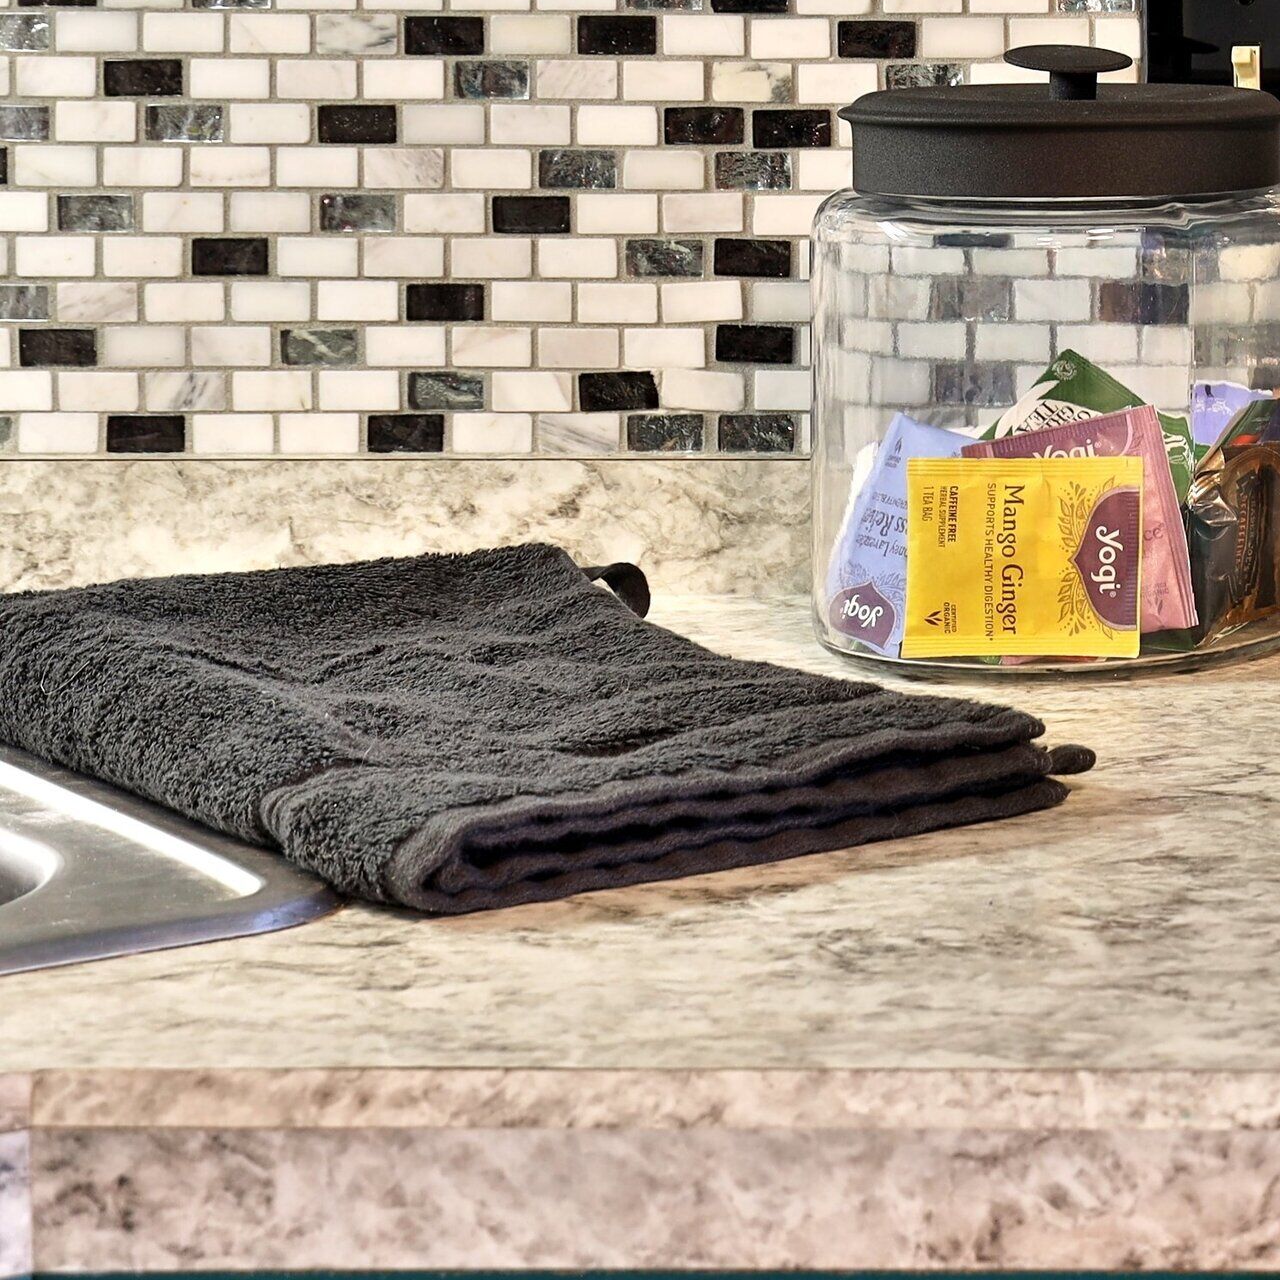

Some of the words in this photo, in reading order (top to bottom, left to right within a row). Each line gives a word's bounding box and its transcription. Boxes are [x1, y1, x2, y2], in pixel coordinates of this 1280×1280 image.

[922, 492, 934, 506] TEA
[922, 506, 932, 522] BAG
[938, 486, 948, 508] HERBAL
[948, 486, 959, 522] CAFFEINE
[984, 483, 996, 538] SUPPORTS
[938, 509, 947, 548] SUPPLEMENT
[948, 523, 957, 542] FREE
[996, 484, 1025, 558] Mango
[983, 539, 994, 584] HEALTHY
[996, 564, 1024, 635] Ginger
[944, 602, 952, 634] ORGANIC
[950, 604, 958, 633] CERTIFIED
